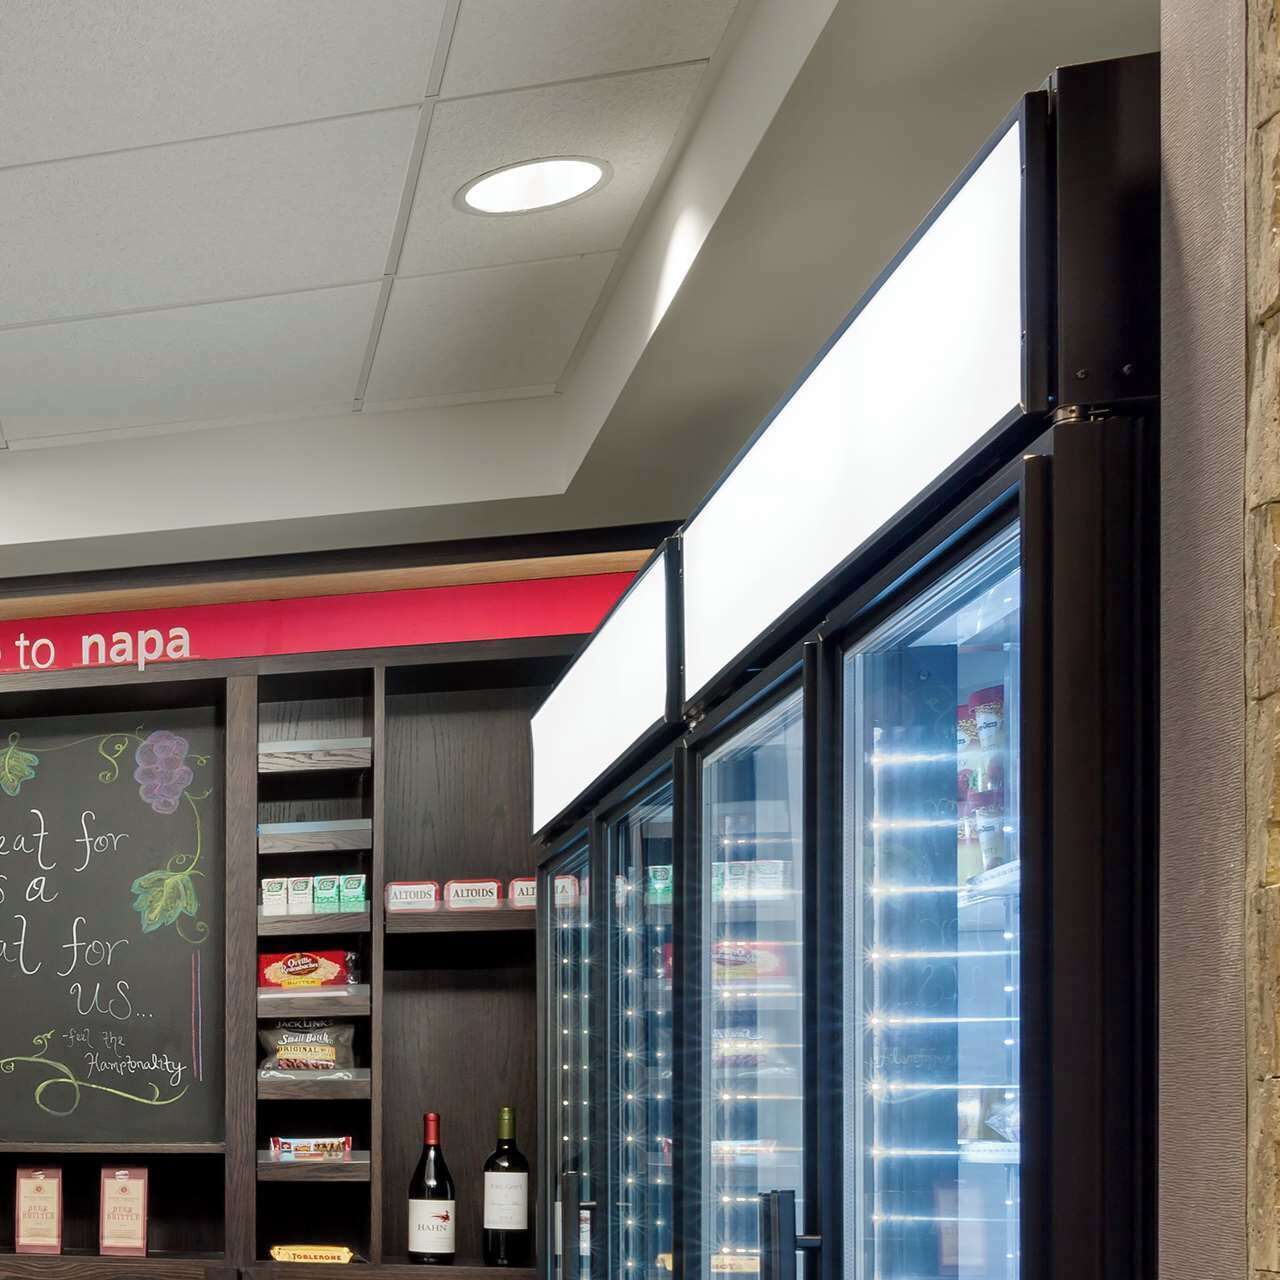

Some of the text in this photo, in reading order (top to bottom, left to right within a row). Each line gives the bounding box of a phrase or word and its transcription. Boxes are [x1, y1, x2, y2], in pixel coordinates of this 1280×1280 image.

[15, 632, 55, 669] to
[81, 626, 191, 671] napa
[74, 811, 129, 871] for
[25, 871, 58, 903] a
[452, 886, 495, 899] ALTOIDS
[392, 888, 432, 900] ALTOIDS
[57, 917, 129, 976] for
[278, 1032, 329, 1045] Small Batch
[417, 1224, 447, 1232] HAHN
[291, 1252, 342, 1261] TOBLERONE
